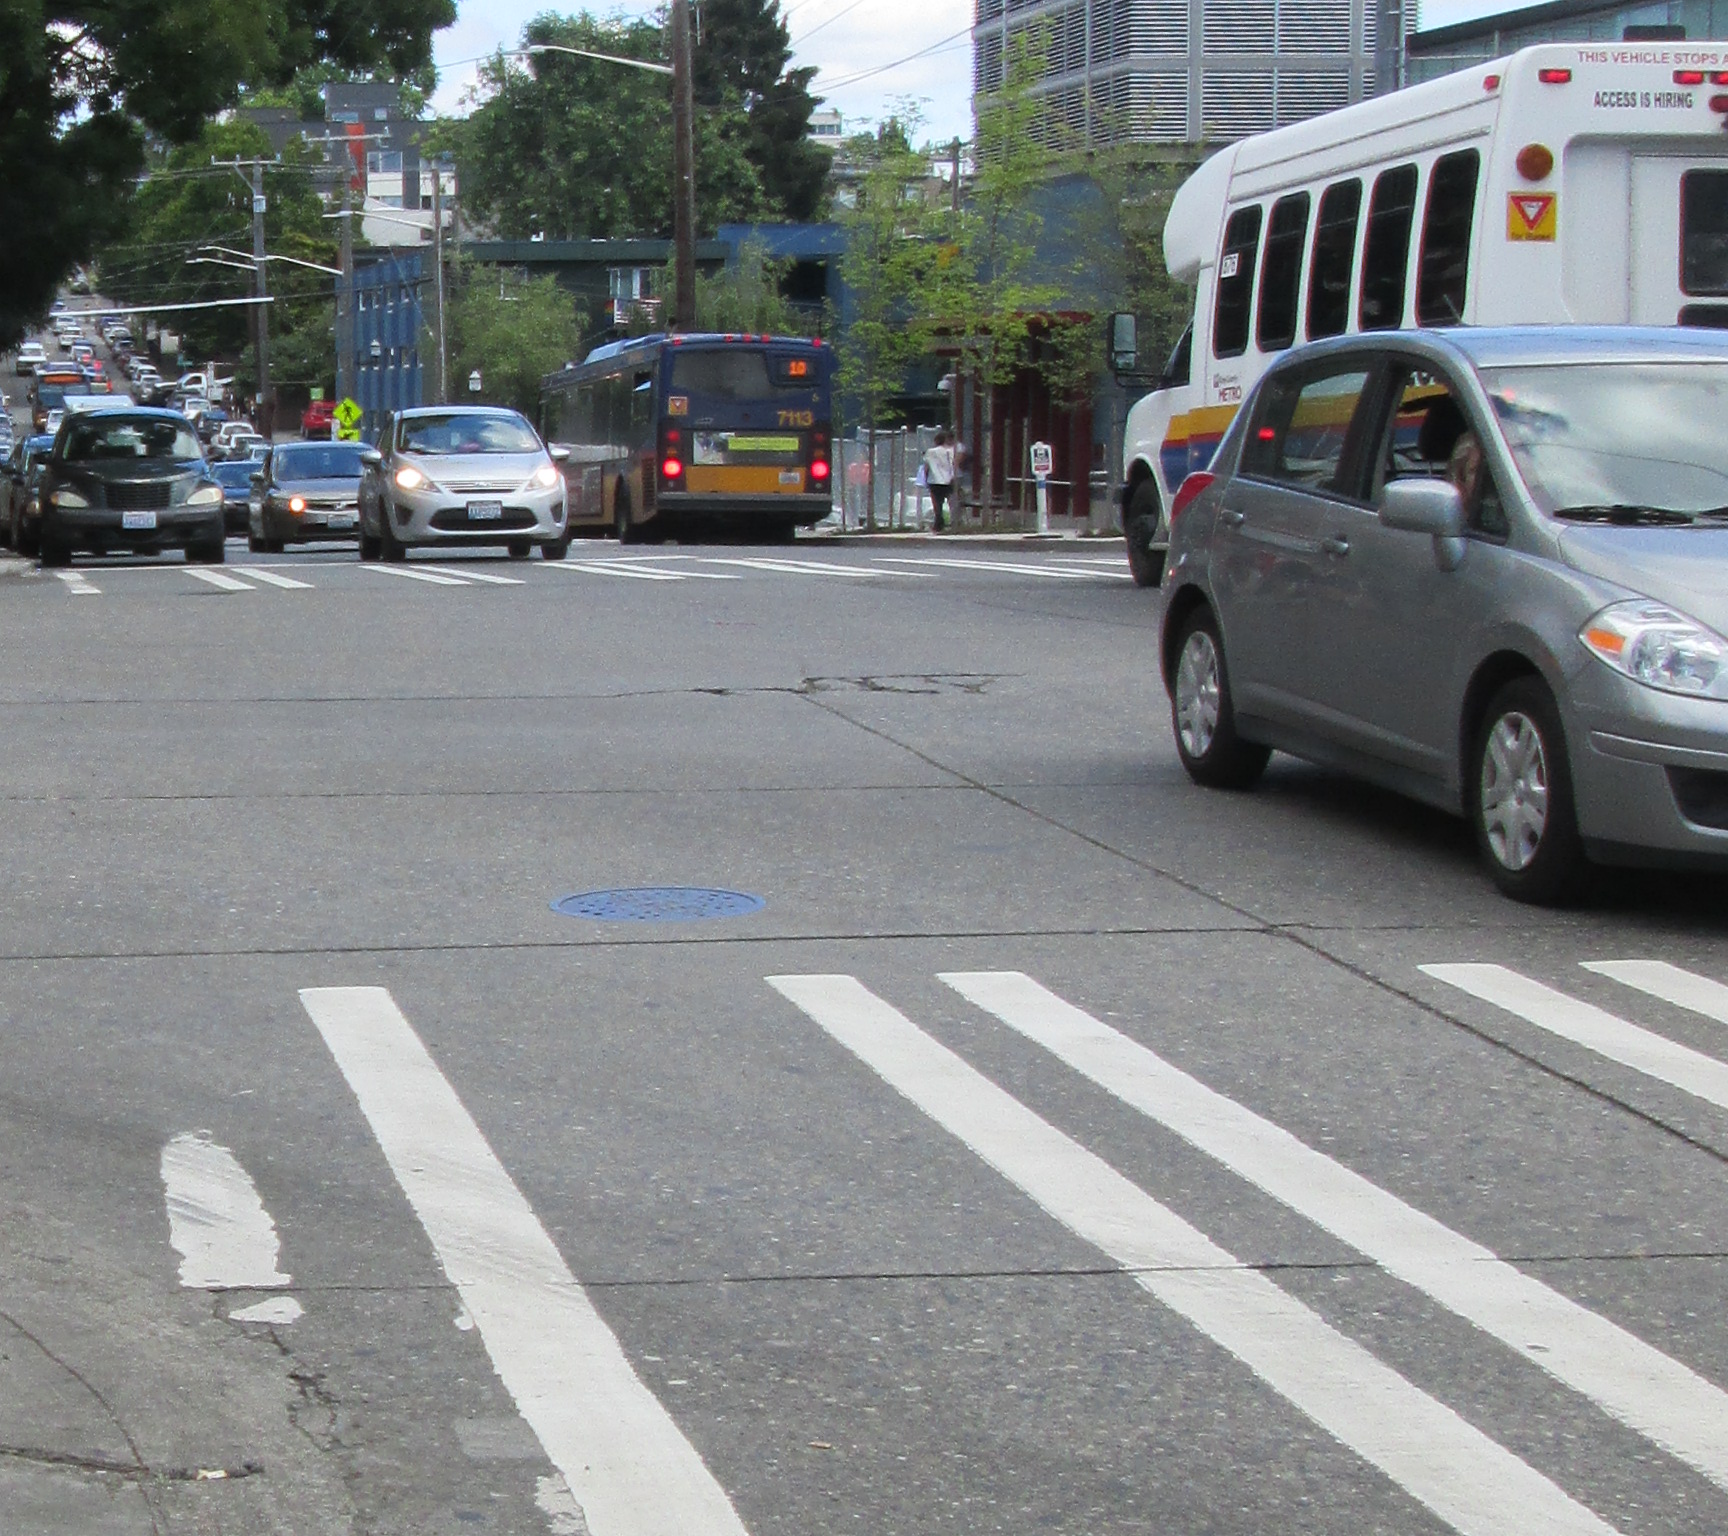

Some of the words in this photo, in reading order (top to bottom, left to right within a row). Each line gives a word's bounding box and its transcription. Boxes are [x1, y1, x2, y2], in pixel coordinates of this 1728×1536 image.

[1578, 51, 1608, 63] THIS
[1611, 51, 1671, 64] VEHICLE
[1674, 52, 1719, 65] STOPS
[1594, 91, 1637, 108] ACCESS
[1640, 92, 1651, 108] IS
[1654, 92, 1693, 109] HIRING
[789, 360, 807, 376] 10
[1218, 385, 1242, 403] METRO
[777, 410, 814, 428] 7113
